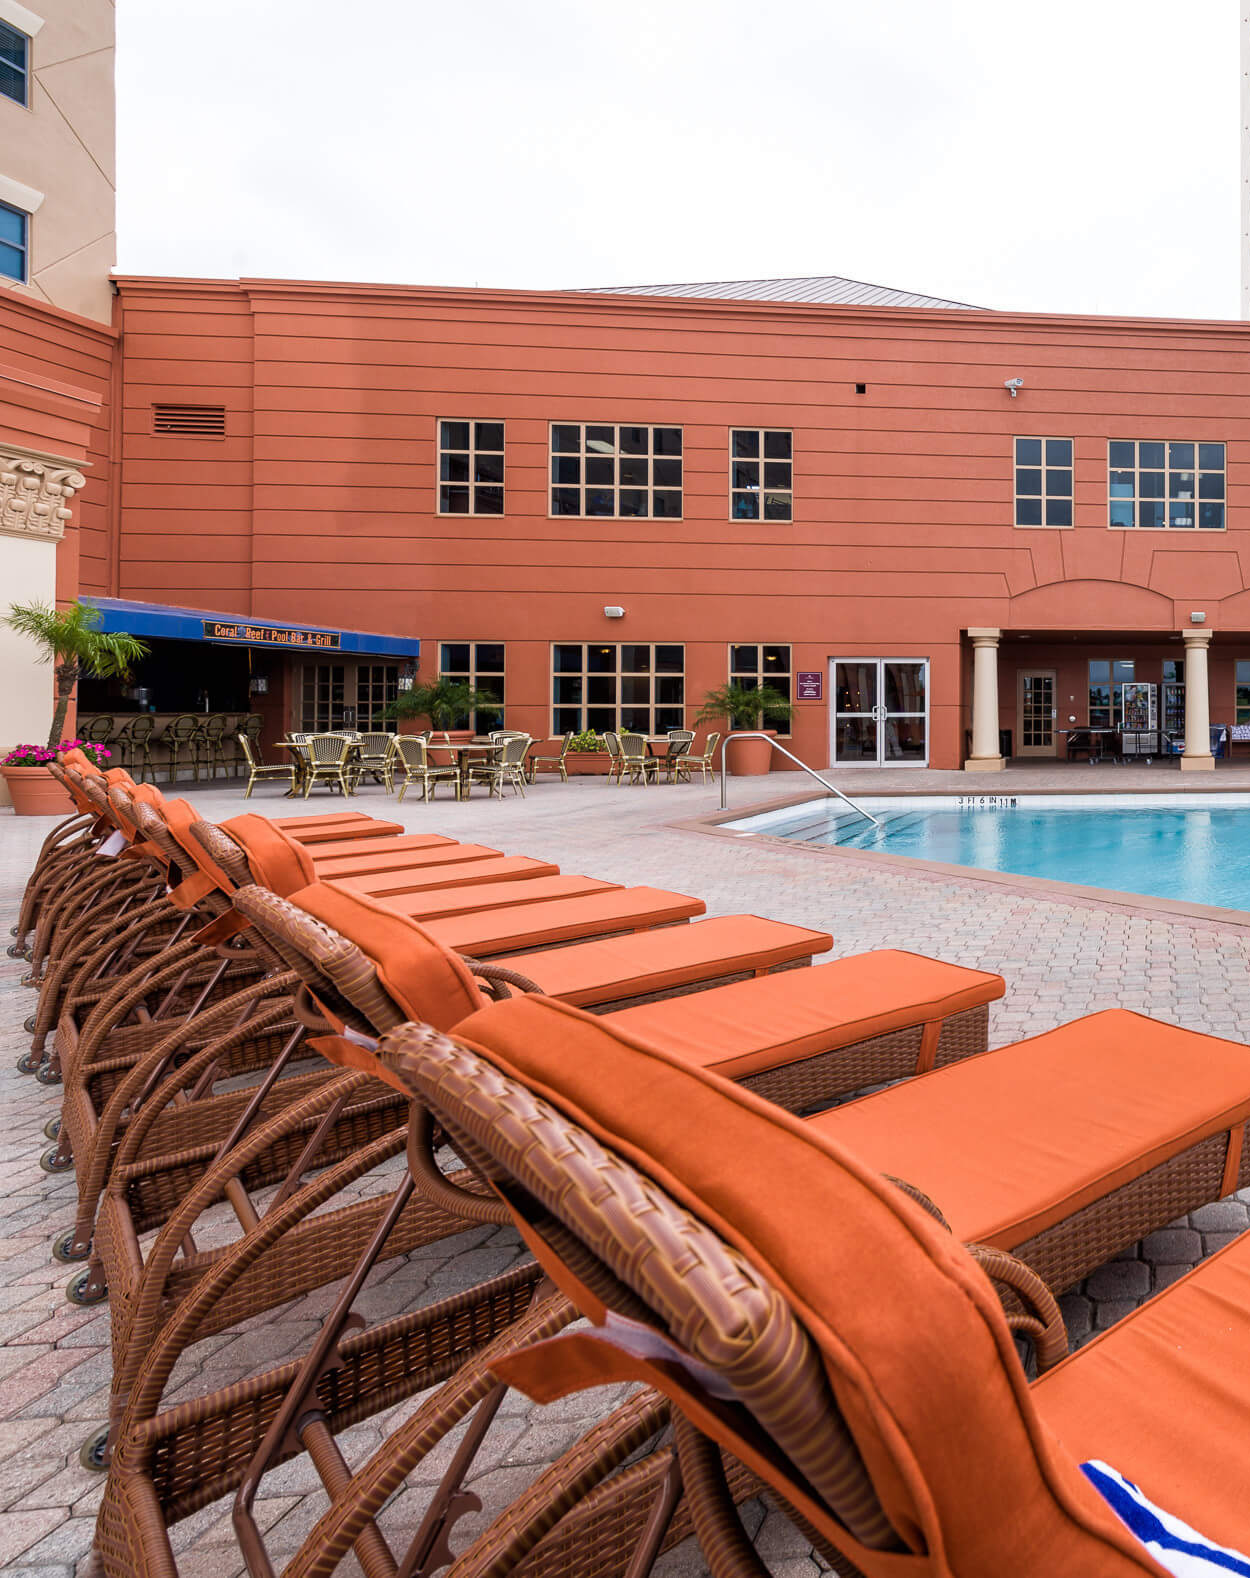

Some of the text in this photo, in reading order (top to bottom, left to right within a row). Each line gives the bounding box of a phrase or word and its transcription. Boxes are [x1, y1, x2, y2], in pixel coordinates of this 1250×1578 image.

[215, 624, 331, 646] Coral Reef Pool Bar & Grill
[958, 796, 964, 804] 3
[967, 796, 975, 804] FT
[980, 796, 985, 804] 6
[989, 796, 997, 804] IN
